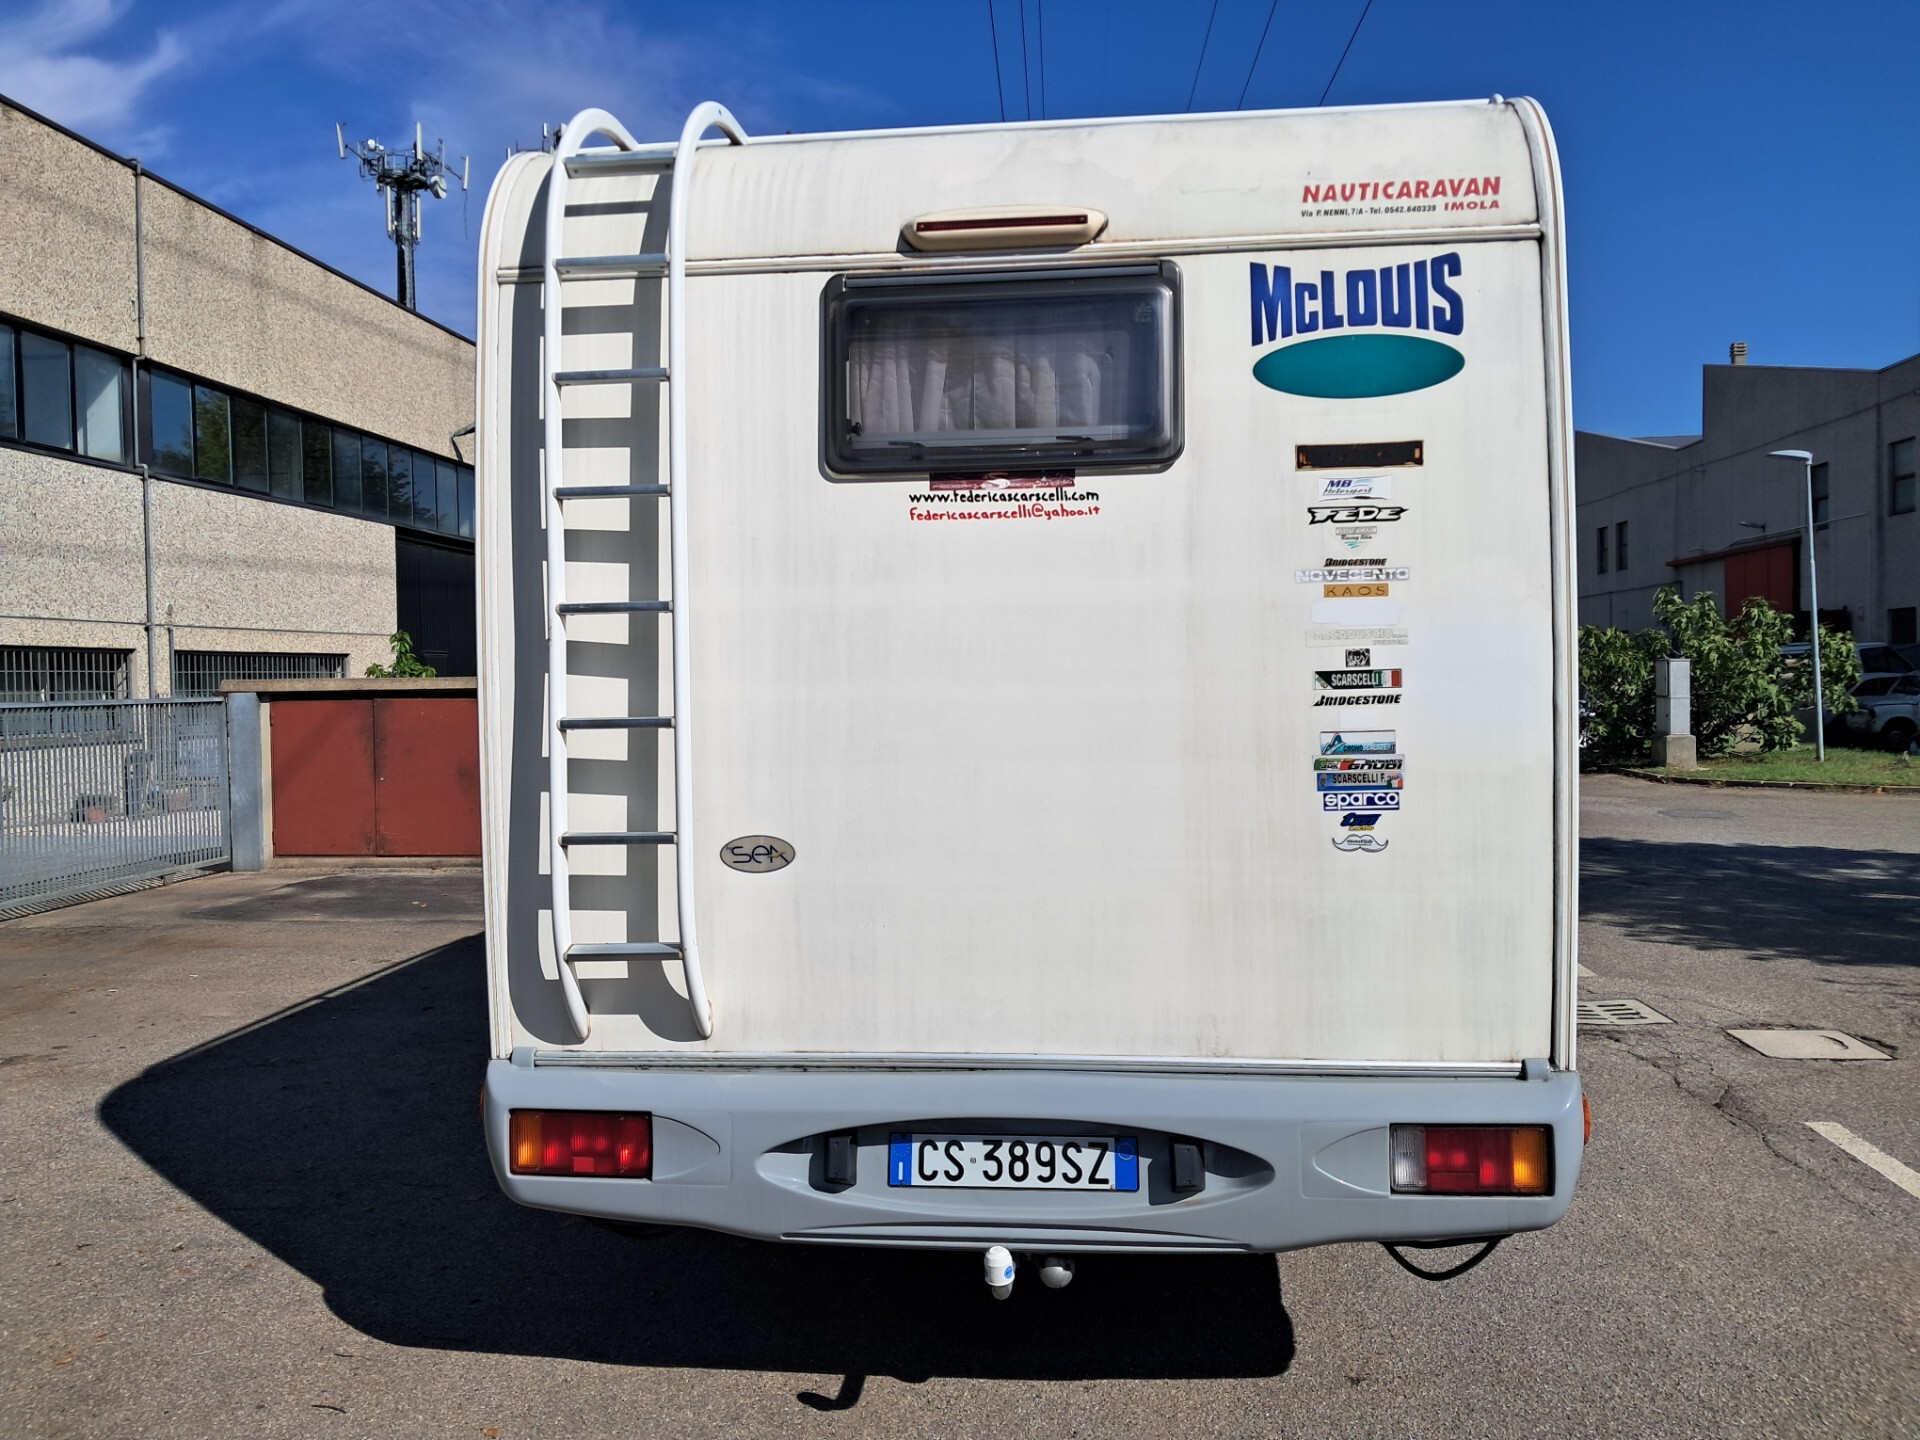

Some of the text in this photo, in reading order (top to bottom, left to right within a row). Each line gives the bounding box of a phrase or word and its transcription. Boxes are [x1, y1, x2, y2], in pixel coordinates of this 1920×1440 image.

[1302, 176, 1501, 204] NAUTICARAVAN
[1301, 209, 1313, 217] Via
[1370, 206, 1383, 215] Tel.
[1444, 199, 1500, 212] IMOLA
[1250, 252, 1465, 347] McLOUIS
[1329, 479, 1353, 488] MB
[1307, 505, 1409, 525] FEDE
[1323, 558, 1388, 568] BRIDGESTONE
[1295, 568, 1409, 582] NOVECENTO
[1326, 585, 1386, 597] KAOS
[1331, 672, 1379, 687] SCARSCELLI
[1313, 693, 1402, 706] BRIDGESTONE
[1332, 773, 1379, 784] SCARSCELLI
[1325, 792, 1399, 810] sparco
[918, 1139, 1111, 1185] CS 389SZ
